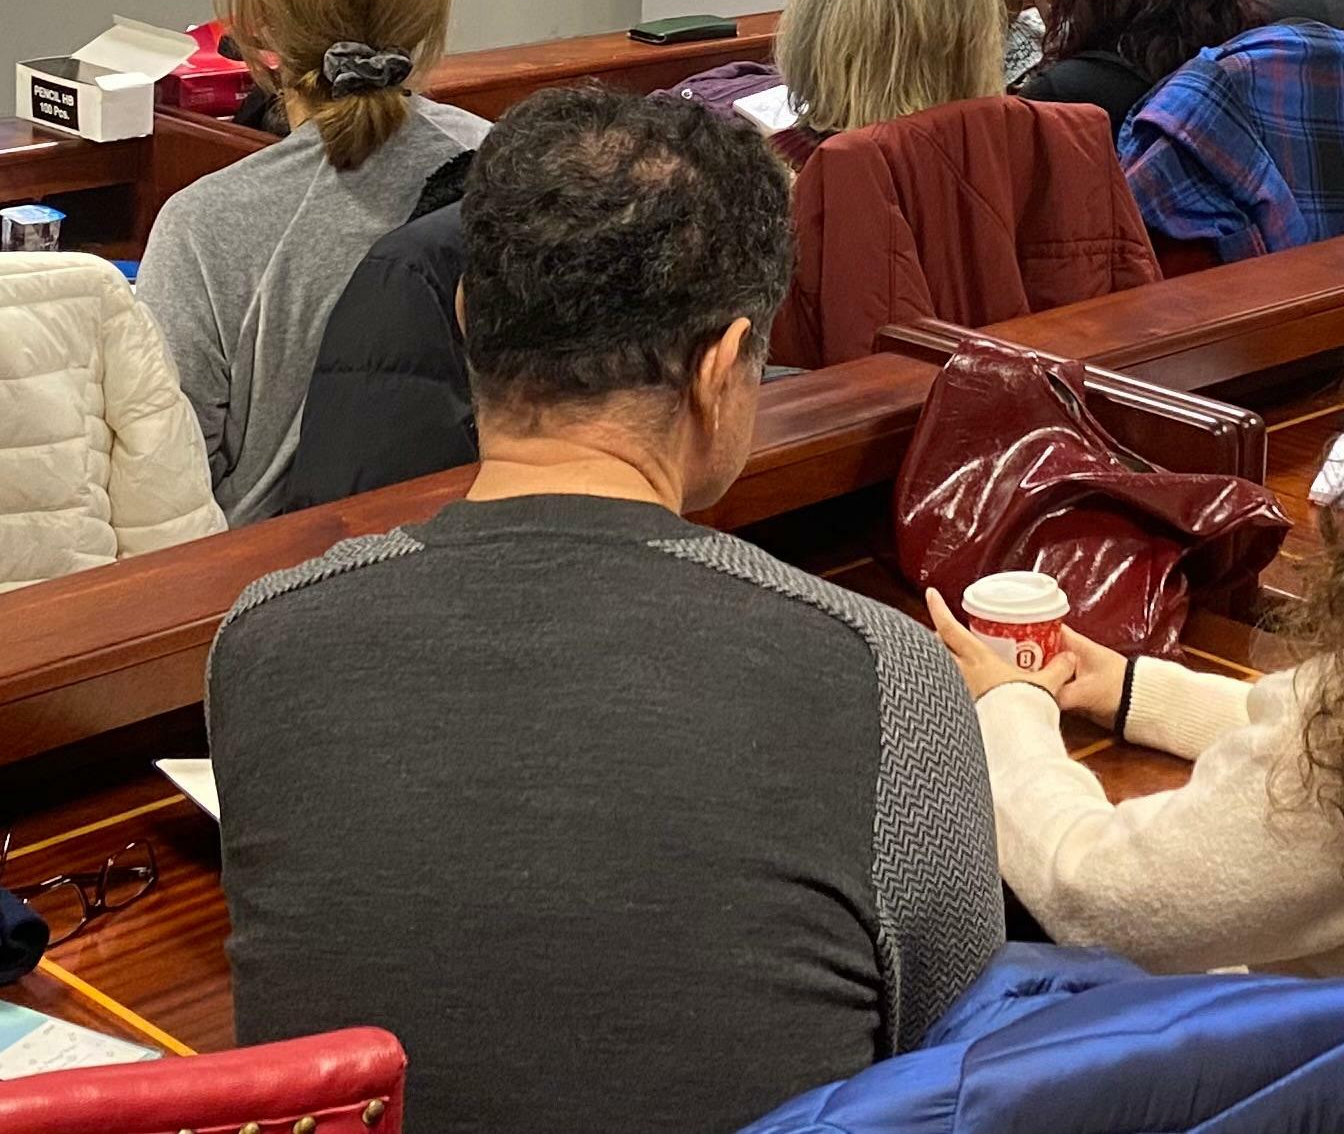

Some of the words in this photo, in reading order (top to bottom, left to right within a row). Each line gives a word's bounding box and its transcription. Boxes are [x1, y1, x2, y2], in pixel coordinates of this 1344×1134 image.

[34, 85, 61, 103] PENCIL
[62, 93, 74, 107] HB
[40, 102, 53, 115] 100
[53, 105, 70, 120] Pcs.
